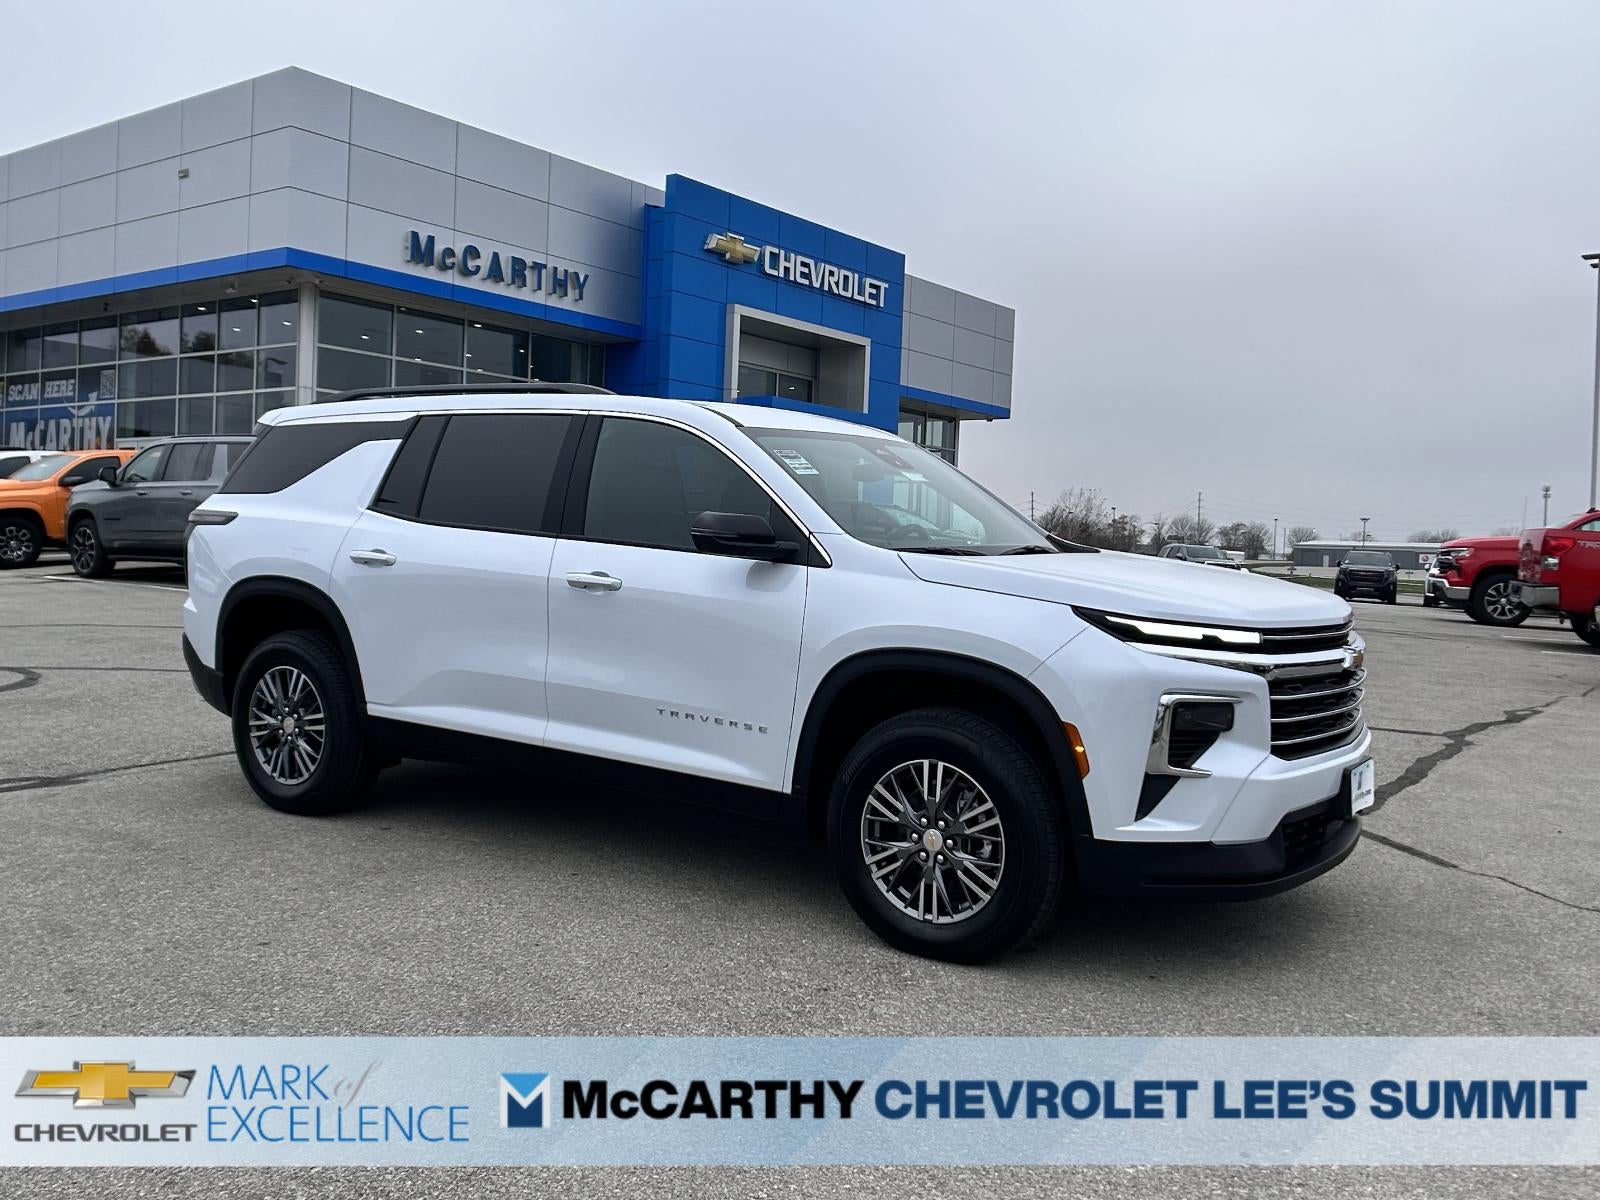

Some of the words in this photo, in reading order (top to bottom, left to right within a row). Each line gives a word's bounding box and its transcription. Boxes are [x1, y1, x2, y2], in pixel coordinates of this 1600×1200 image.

[405, 229, 590, 302] McCARTHY
[761, 244, 889, 308] CHEVROLET
[8, 383, 38, 401] SCAN
[43, 378, 76, 398] HERE
[9, 415, 112, 450] McCARTHY
[656, 707, 768, 734] TRAVERSE
